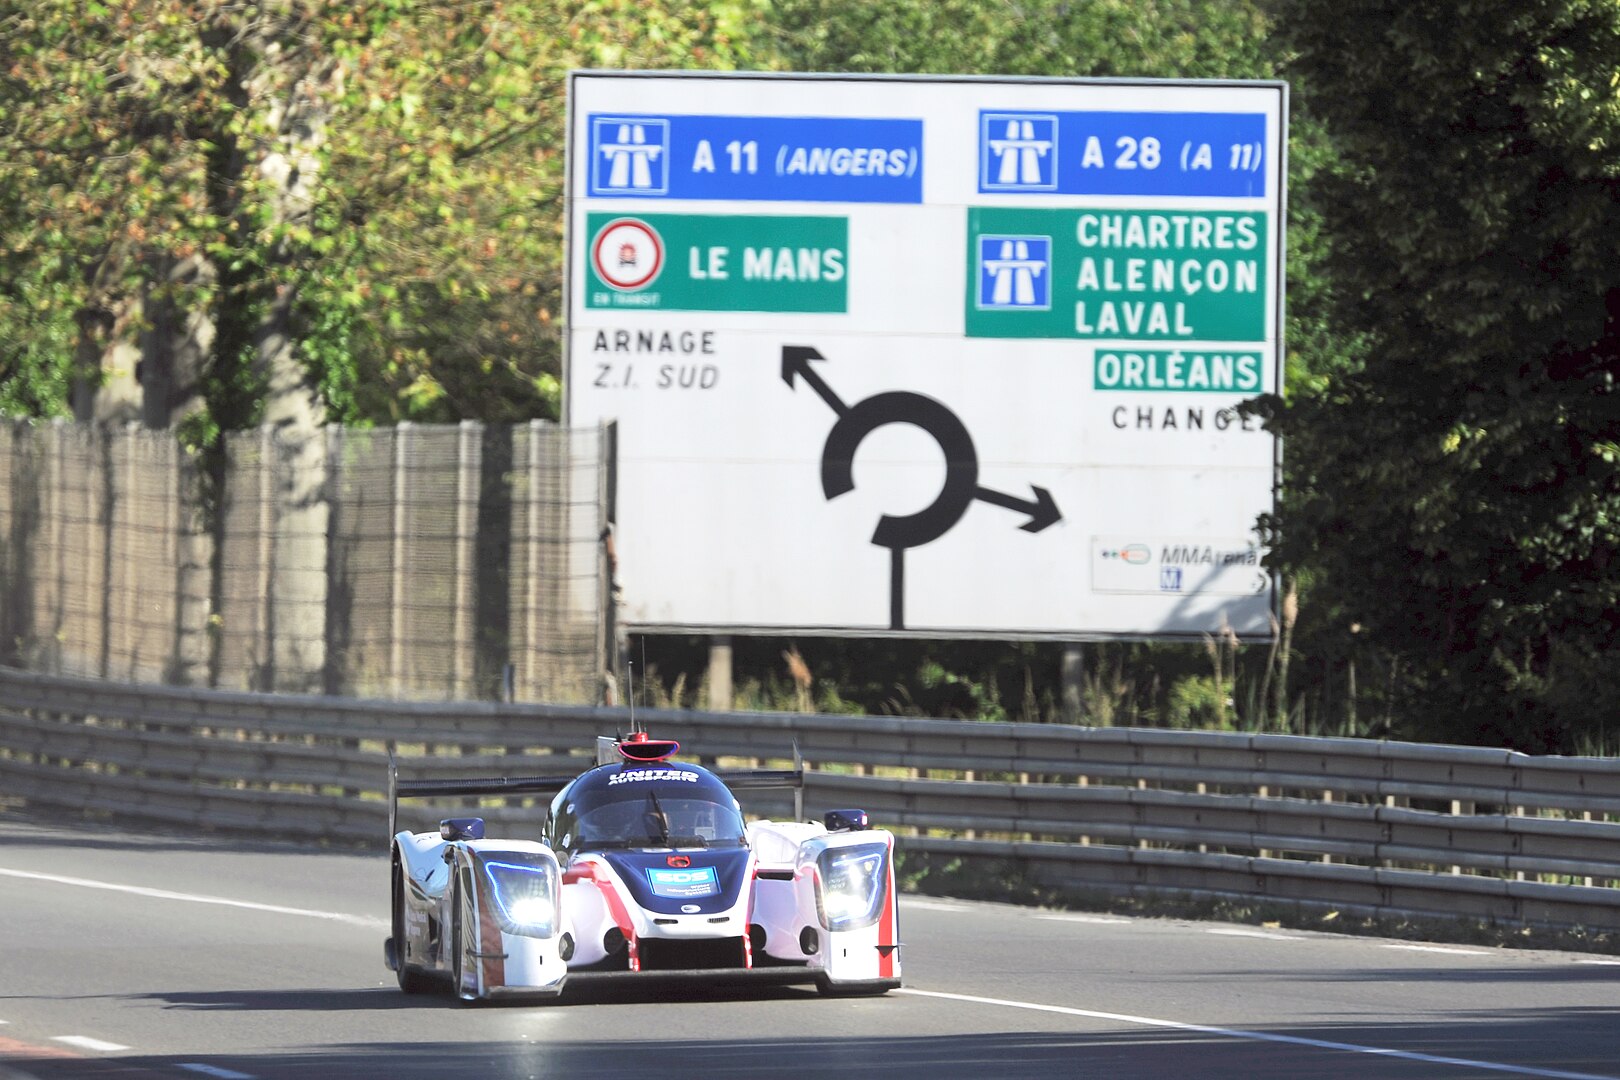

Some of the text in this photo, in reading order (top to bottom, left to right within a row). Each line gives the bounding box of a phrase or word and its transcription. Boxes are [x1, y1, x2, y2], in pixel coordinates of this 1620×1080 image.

[692, 139, 918, 178] A 11 (ANGERS)
[1081, 135, 1262, 172] A 28 (A 11)
[1076, 214, 1258, 250] CHARTRES
[689, 246, 845, 283] LE MANS
[1076, 257, 1258, 295] ALENÇON
[1075, 300, 1193, 335] LAVAL
[594, 330, 716, 354] ARNAGE
[593, 365, 720, 389] Z.I. SUD
[1098, 351, 1258, 389] ORLÉANS
[609, 769, 700, 781] UNITED
[655, 871, 709, 882] SDS
